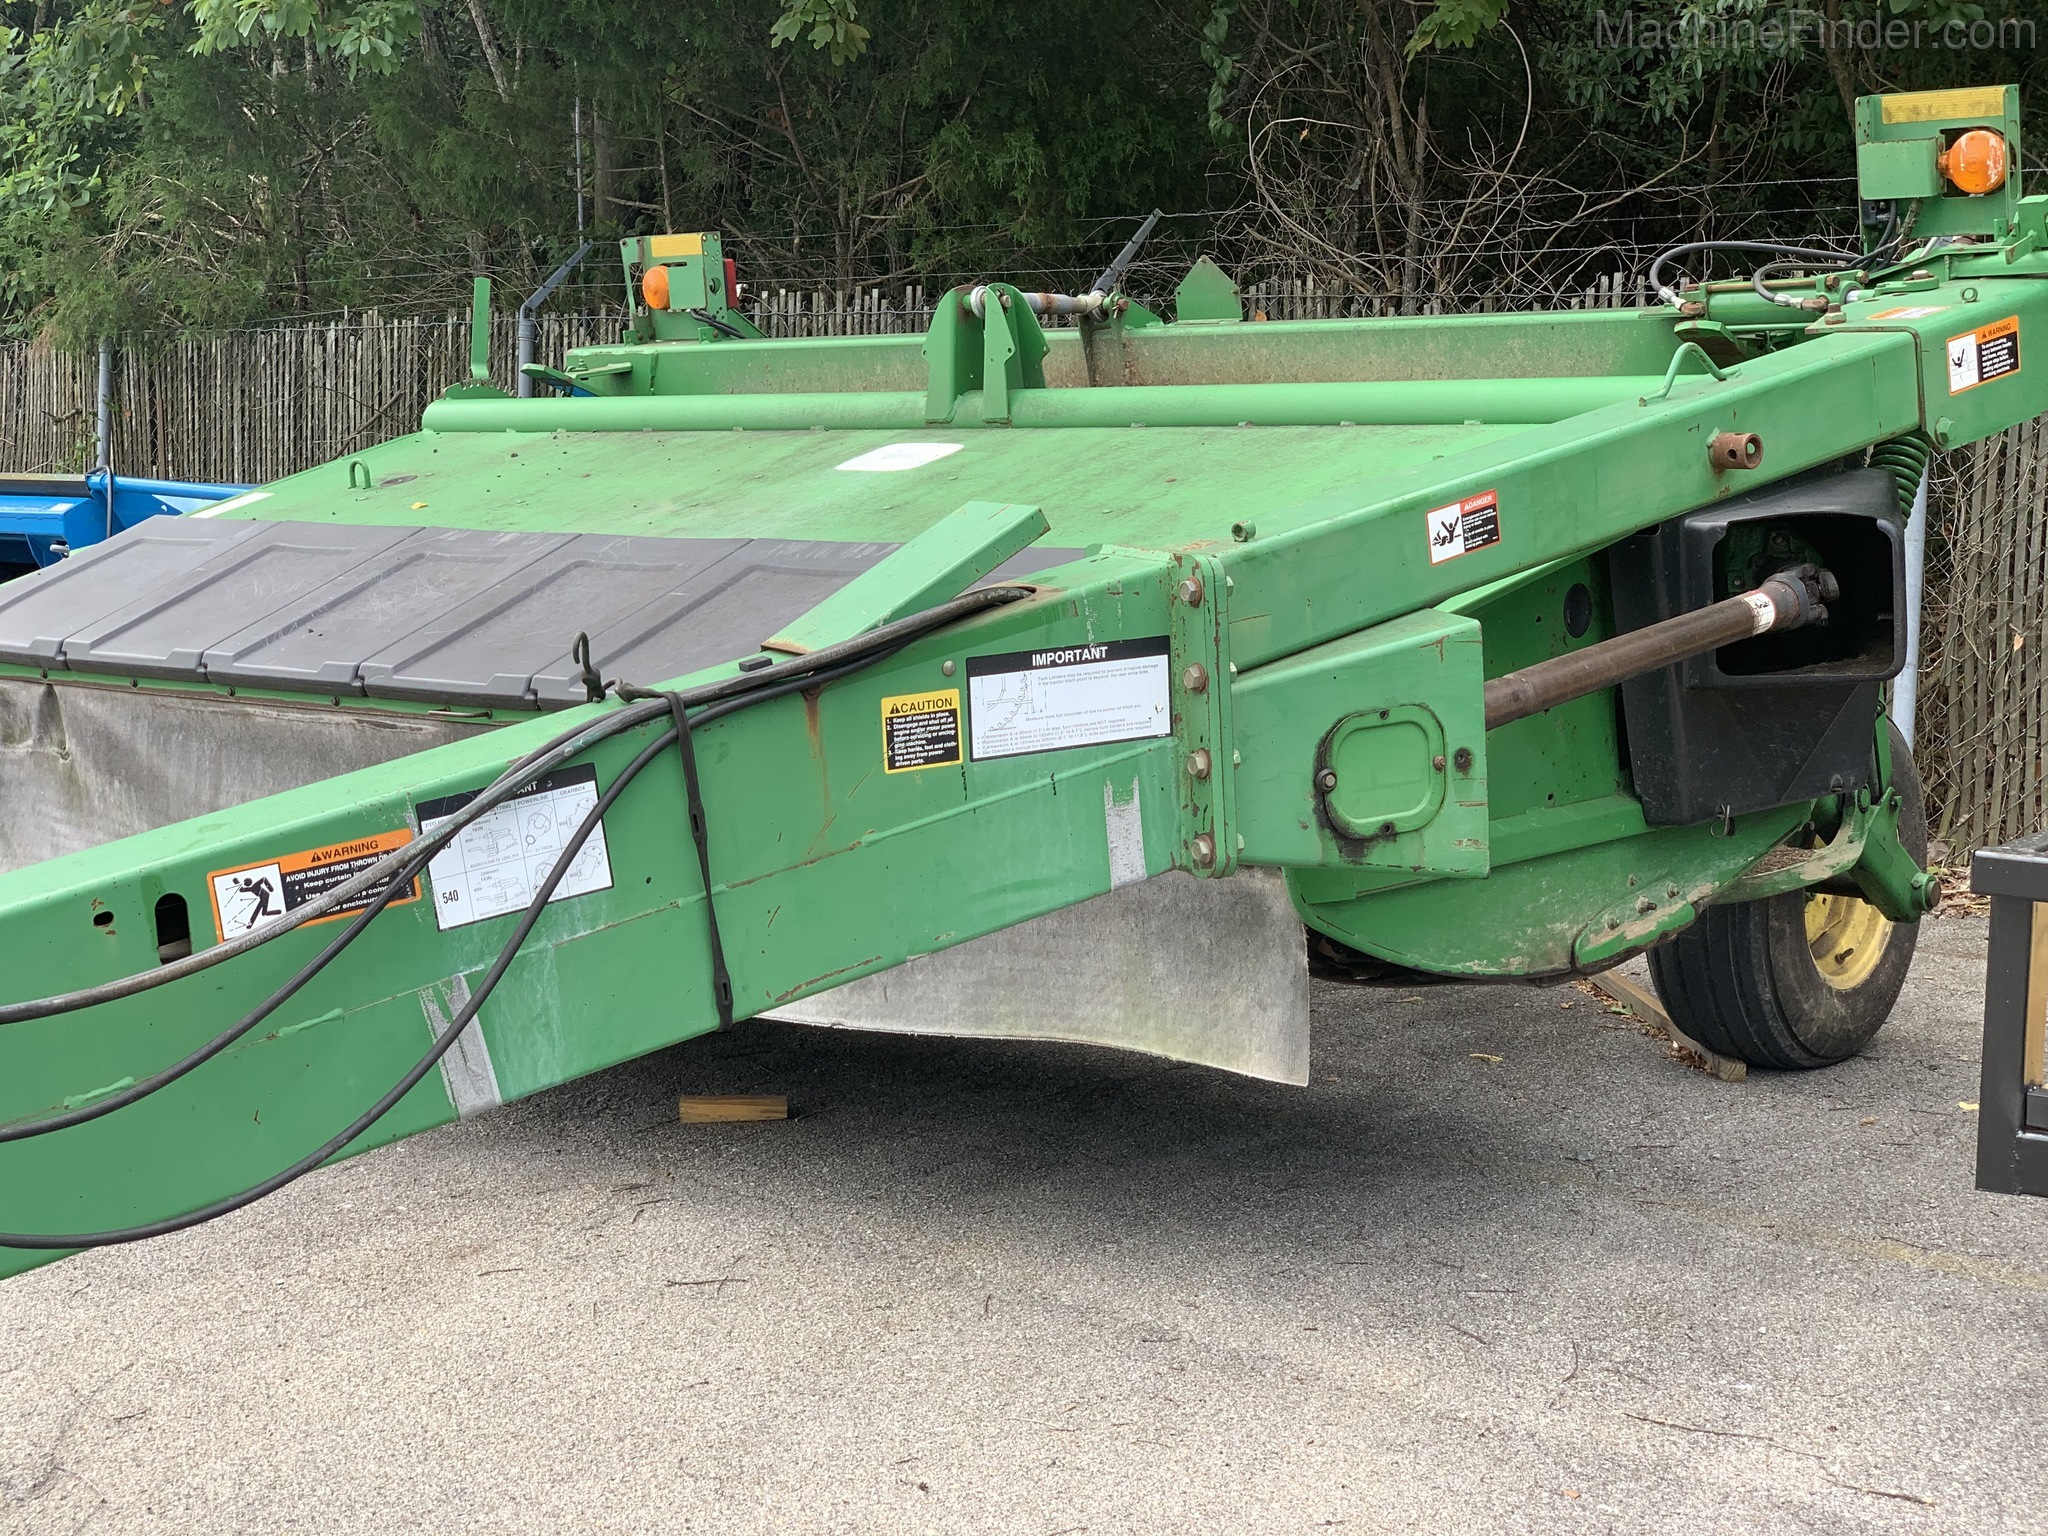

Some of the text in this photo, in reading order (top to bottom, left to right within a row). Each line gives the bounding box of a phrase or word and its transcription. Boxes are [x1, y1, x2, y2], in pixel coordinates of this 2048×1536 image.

[1988, 323, 2011, 337] WARNING
[1468, 495, 1493, 509] DANGER
[1032, 646, 1108, 667] IMPORTANT
[900, 697, 952, 713] CAUTION
[893, 722, 918, 730] Disengage
[560, 785, 586, 795] GEARBOX
[517, 794, 549, 806] POWERLINE
[321, 840, 379, 860] WARNING
[286, 871, 306, 883] AVOID
[307, 866, 330, 878] INJURY
[331, 862, 350, 873] FROM
[350, 855, 378, 868] THROWN
[303, 878, 324, 889] Keep
[325, 872, 352, 884] curtain
[342, 896, 378, 910] enclosur
[442, 889, 459, 904] 540
